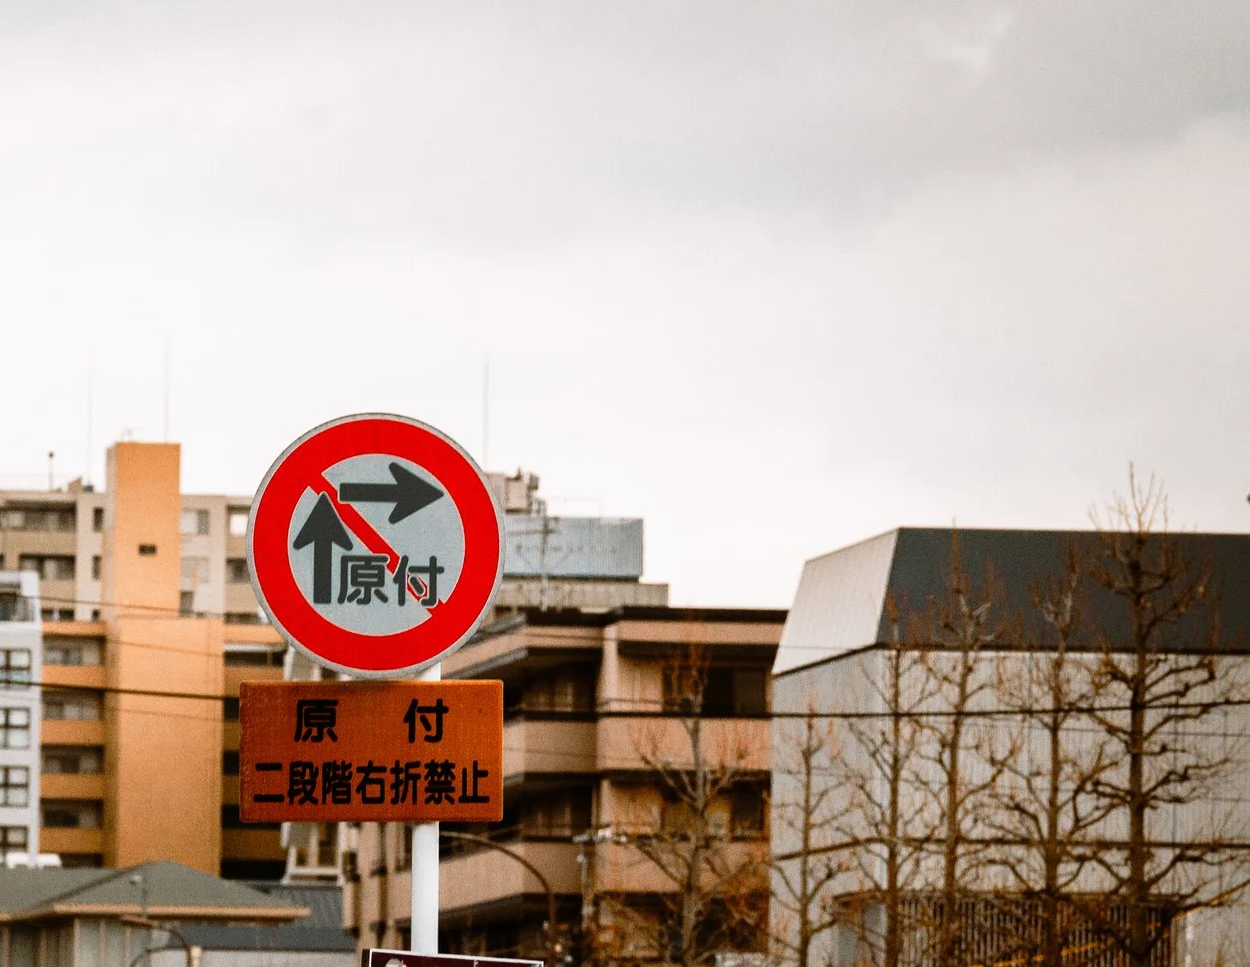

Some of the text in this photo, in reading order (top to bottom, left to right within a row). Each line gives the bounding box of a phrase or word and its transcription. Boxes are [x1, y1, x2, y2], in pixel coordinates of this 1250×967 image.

[337, 555, 445, 607] 原付
[253, 758, 490, 805] 二段階右折禁止
